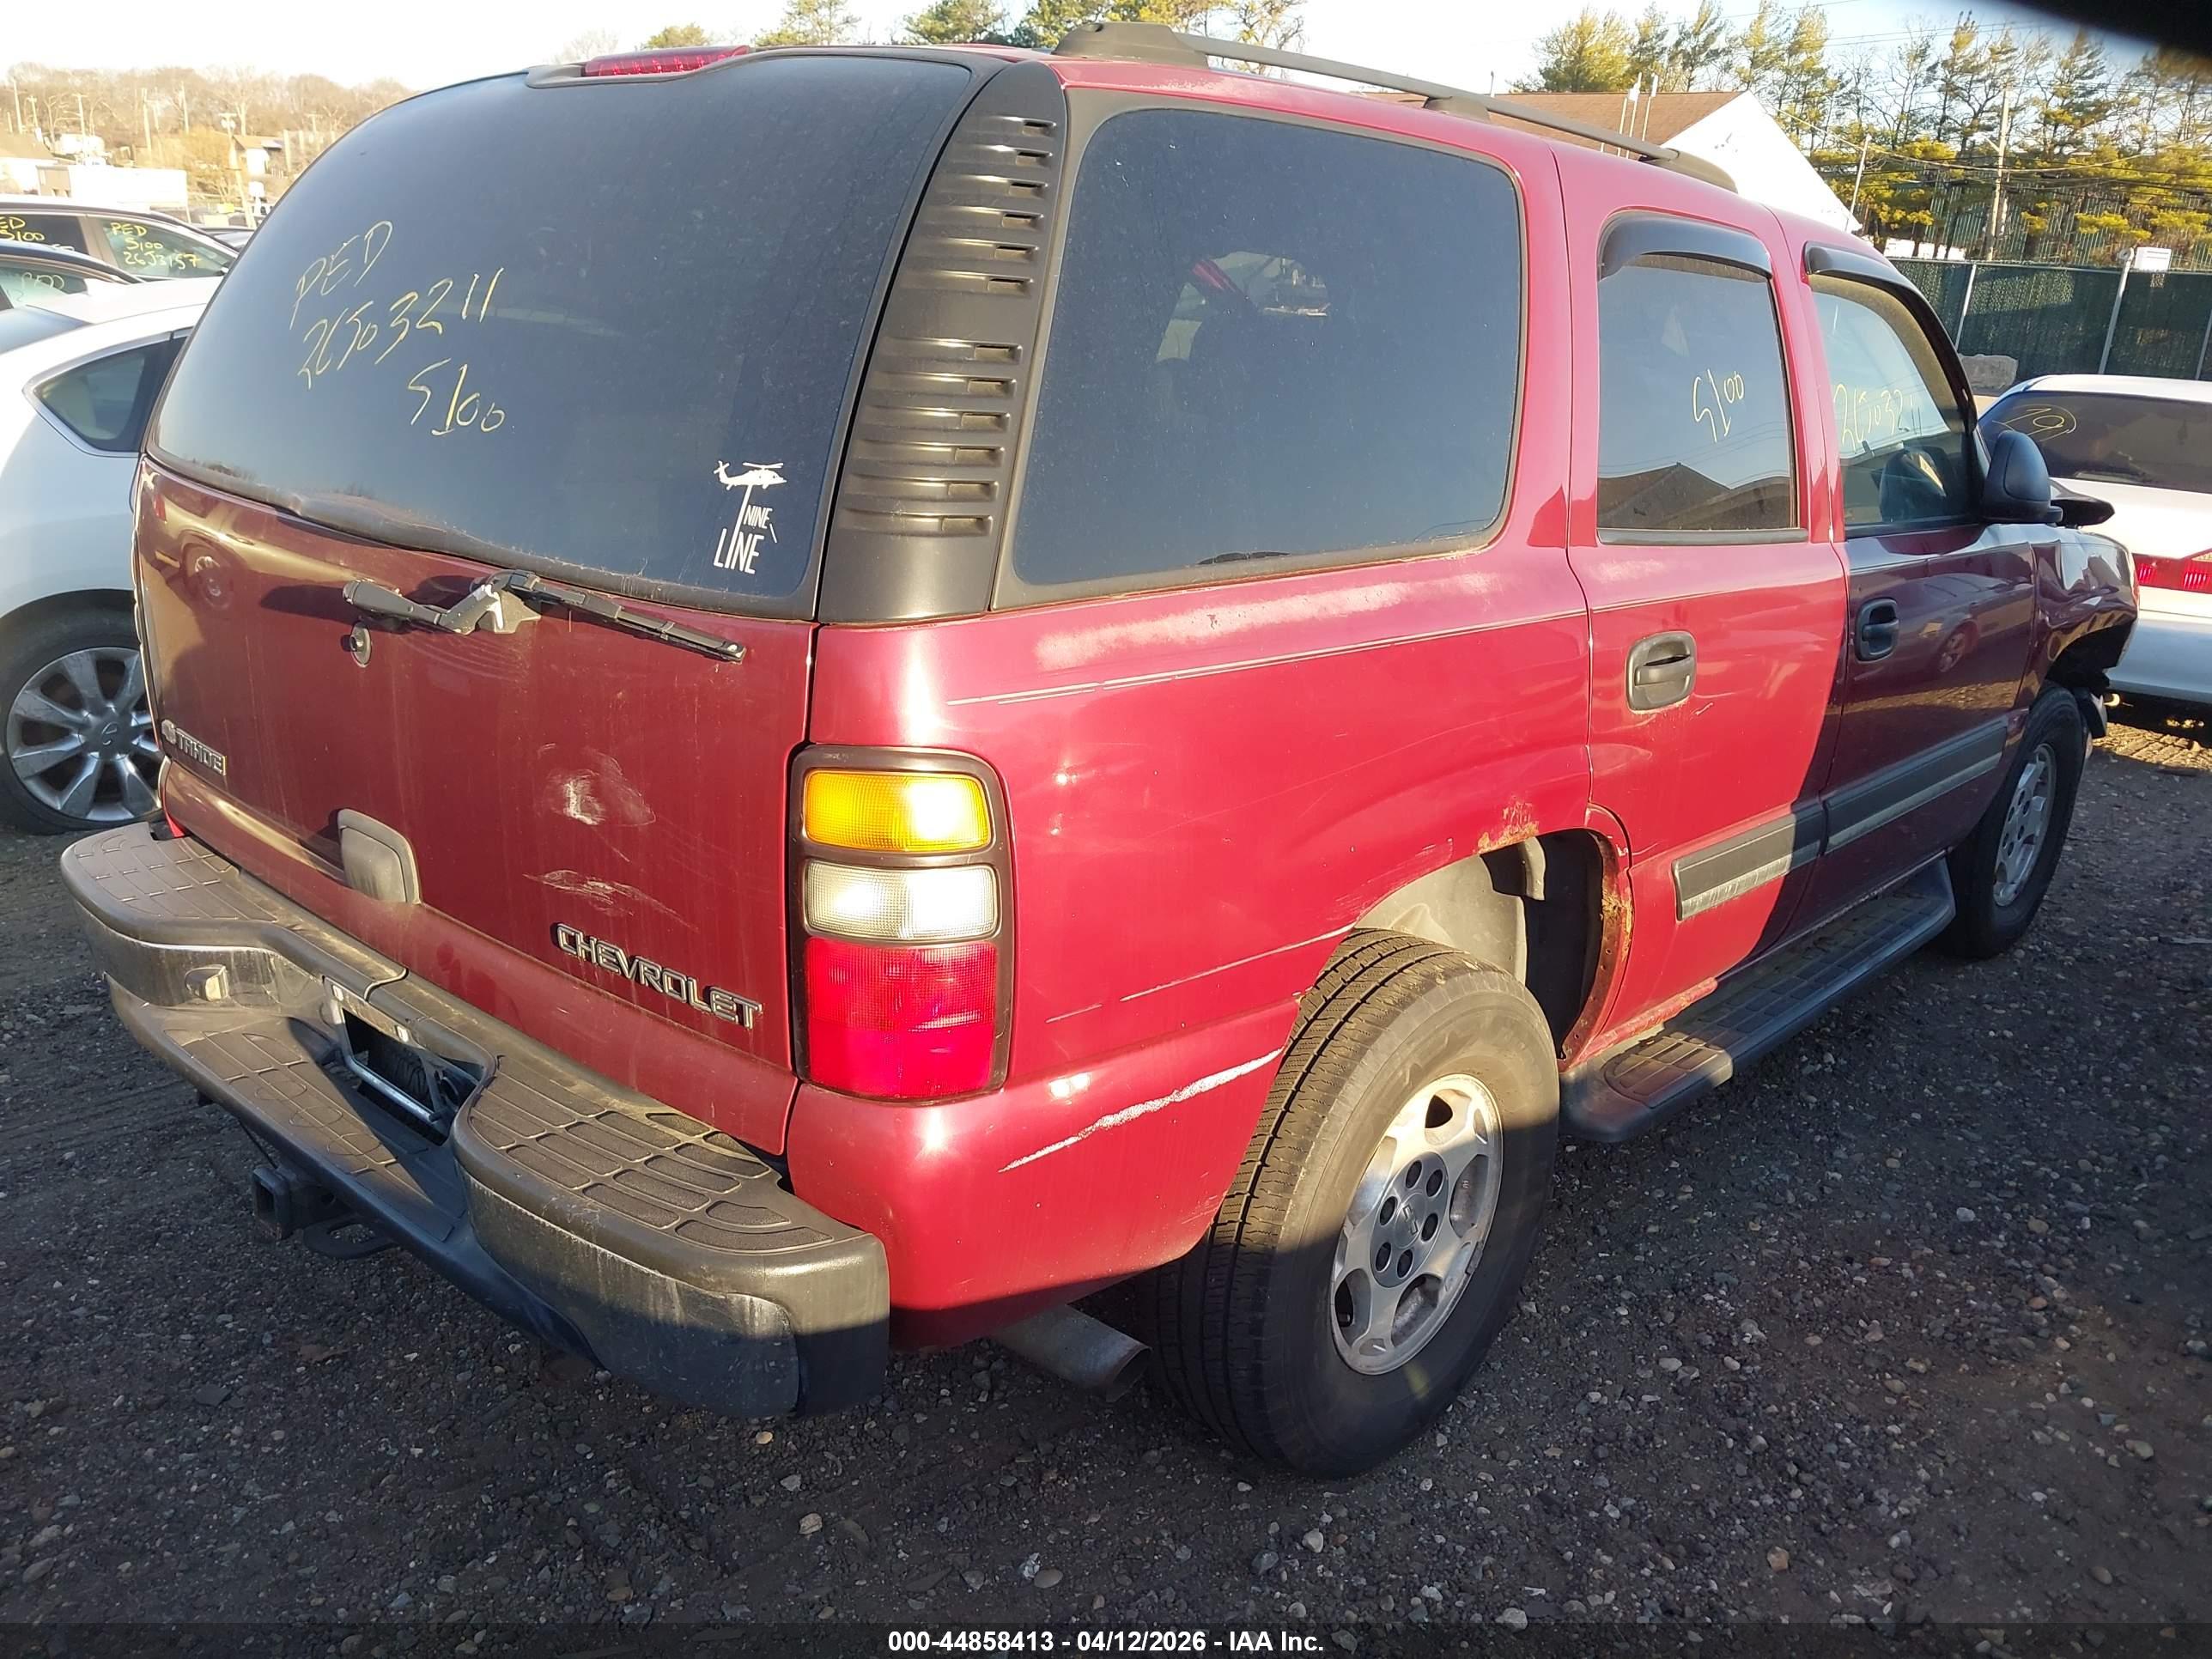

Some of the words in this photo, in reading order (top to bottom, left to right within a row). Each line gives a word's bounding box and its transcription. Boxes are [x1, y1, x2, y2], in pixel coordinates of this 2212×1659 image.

[0, 216, 26, 229] ED
[110, 222, 147, 236] PED
[289, 220, 392, 330] PED
[743, 504, 773, 529] NINE
[714, 528, 765, 574] LINE
[556, 922, 763, 1030] CHEVROLET
